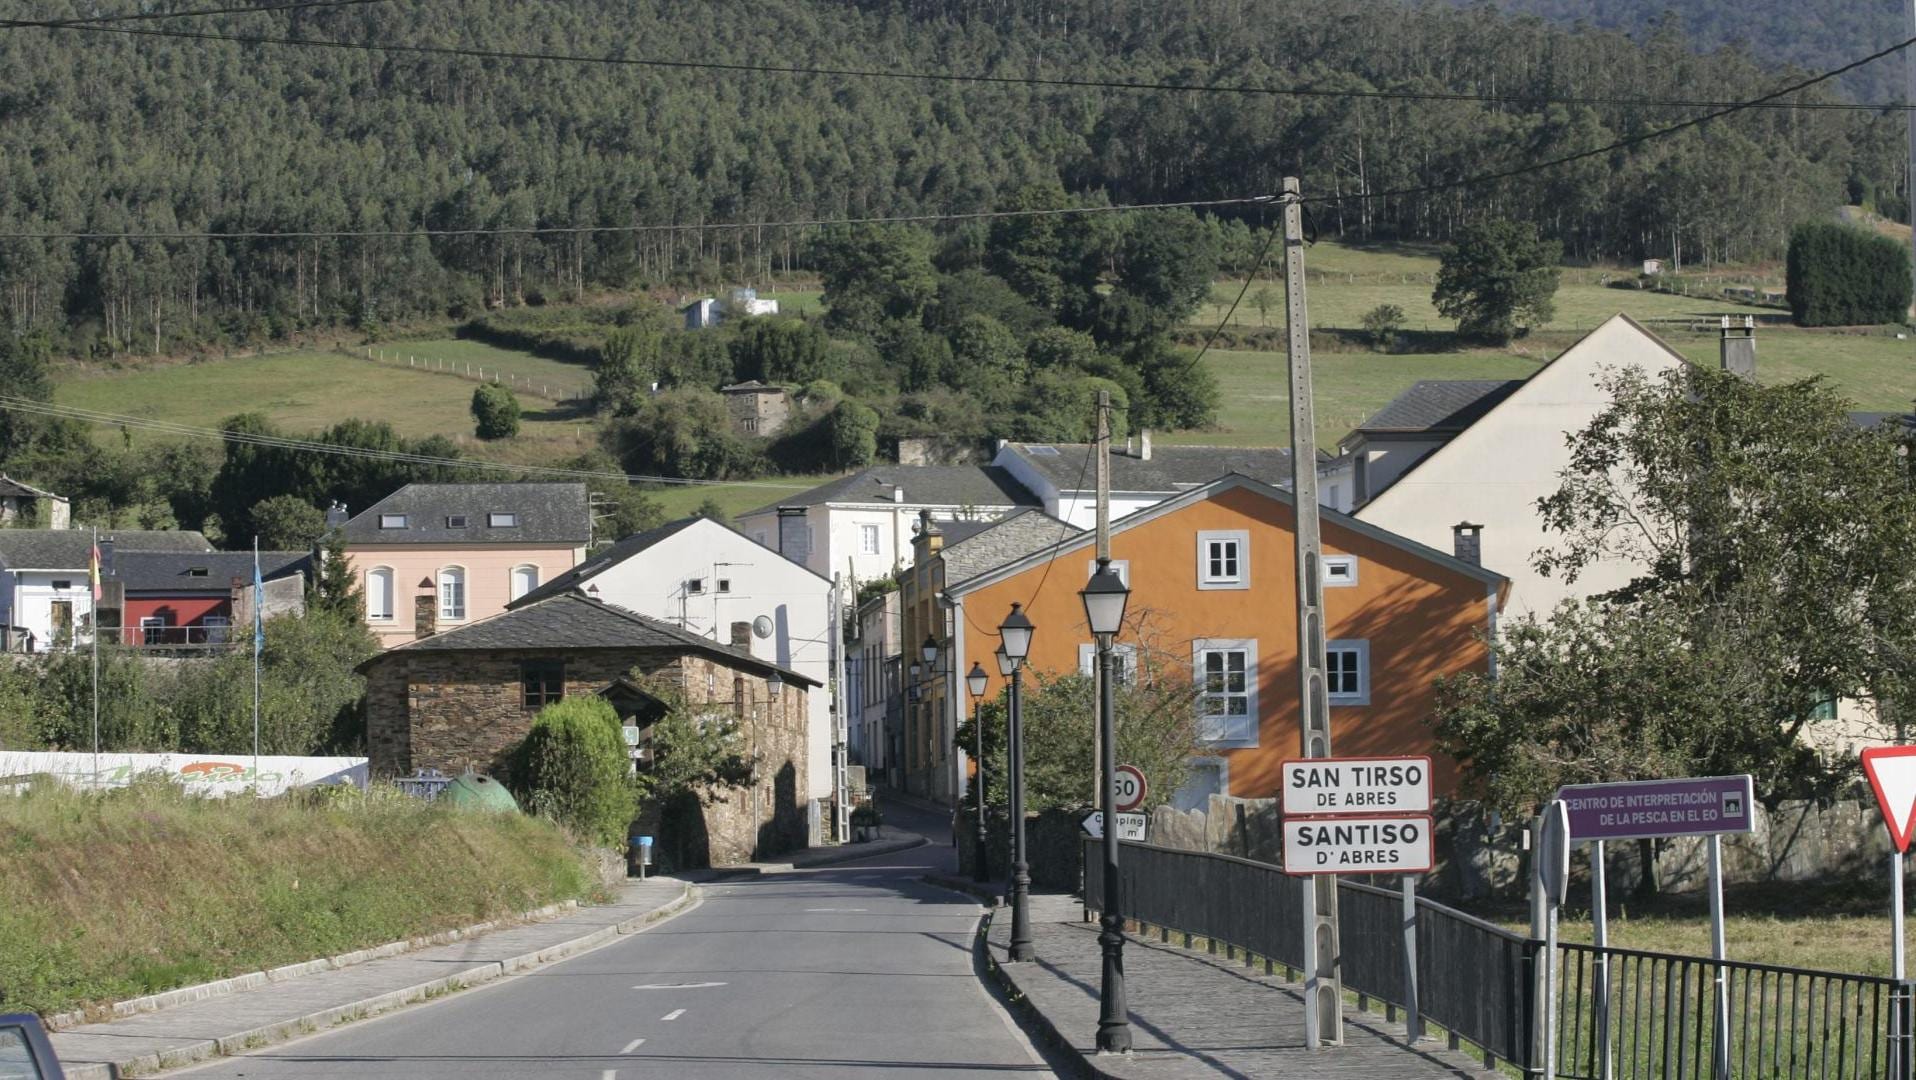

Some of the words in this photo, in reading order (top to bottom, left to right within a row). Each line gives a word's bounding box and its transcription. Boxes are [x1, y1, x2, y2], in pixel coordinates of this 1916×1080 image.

[1292, 768, 1340, 788] SAN
[1351, 765, 1422, 787] TIRSO
[1317, 792, 1337, 806] DE
[1344, 791, 1397, 806] ABRES
[1567, 796, 1608, 811] CENTRO
[1610, 795, 1625, 808] DE
[1627, 788, 1717, 808] INTERPRETACIÓN
[1095, 814, 1144, 828] Cping
[1600, 813, 1615, 826] DE
[1616, 812, 1631, 825] LA
[1632, 810, 1668, 824] PESCA
[1670, 809, 1686, 822] EN
[1688, 809, 1701, 822] EL
[1703, 808, 1718, 821] EO
[1297, 823, 1419, 846] SANTISO
